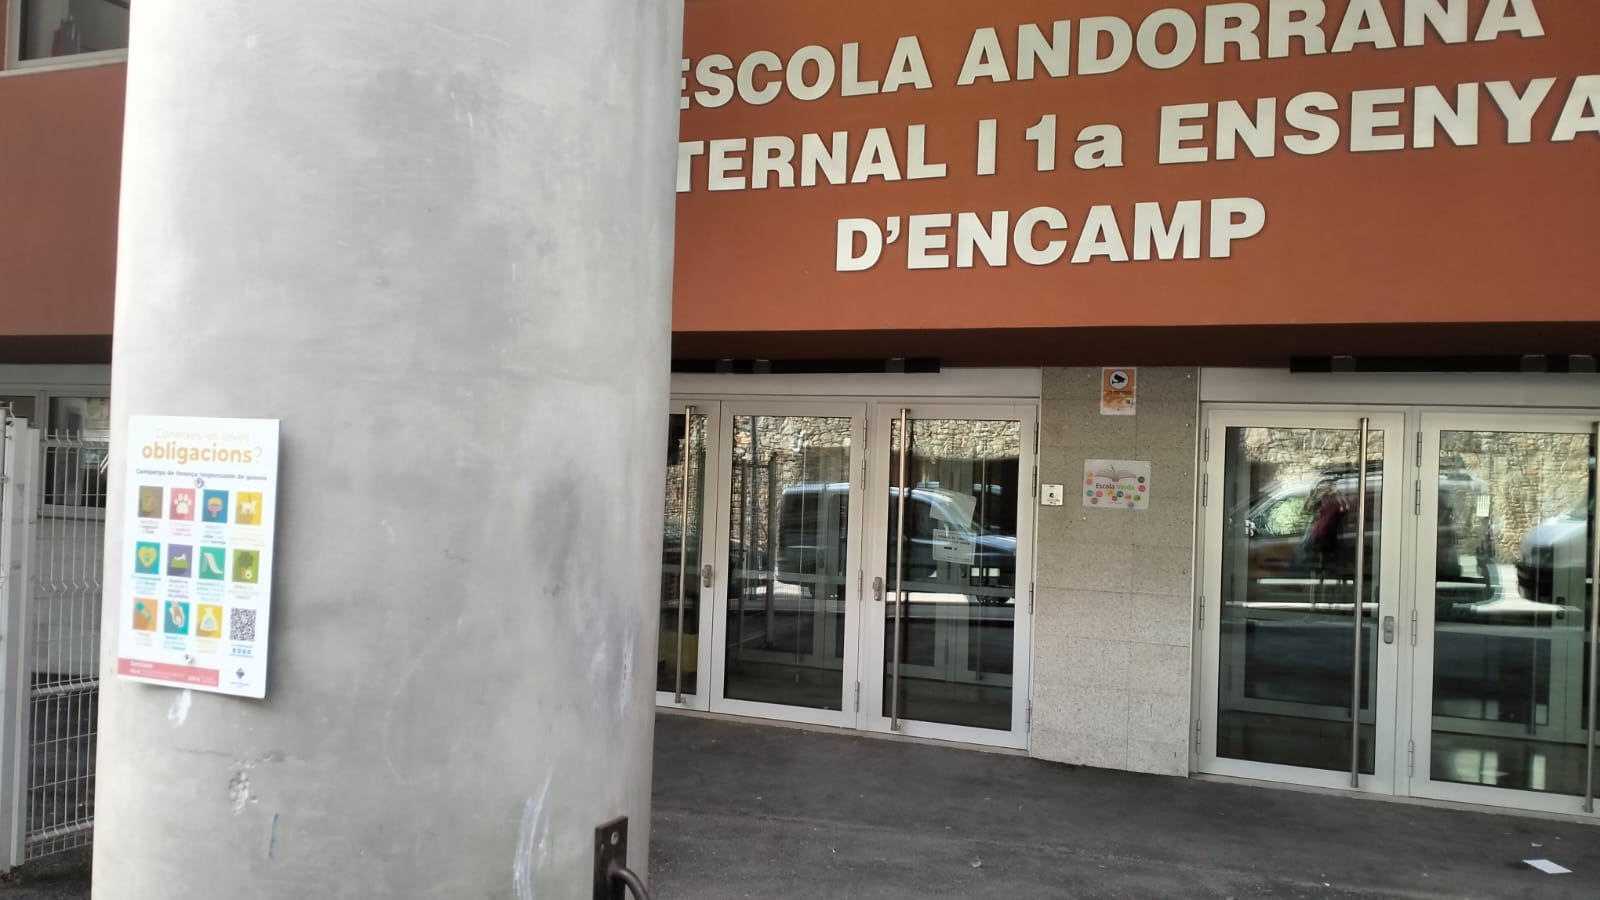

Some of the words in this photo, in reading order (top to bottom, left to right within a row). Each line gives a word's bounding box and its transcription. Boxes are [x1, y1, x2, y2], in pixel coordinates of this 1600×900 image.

[680, 35, 933, 110] SCOLA
[957, 0, 1546, 86] ANDORRANA
[977, 118, 997, 176] I
[1025, 113, 1125, 172] 1a
[1158, 74, 1600, 165] ENSENYA
[835, 196, 1267, 272] D'ENCAMP
[142, 441, 263, 465] obligacions?
